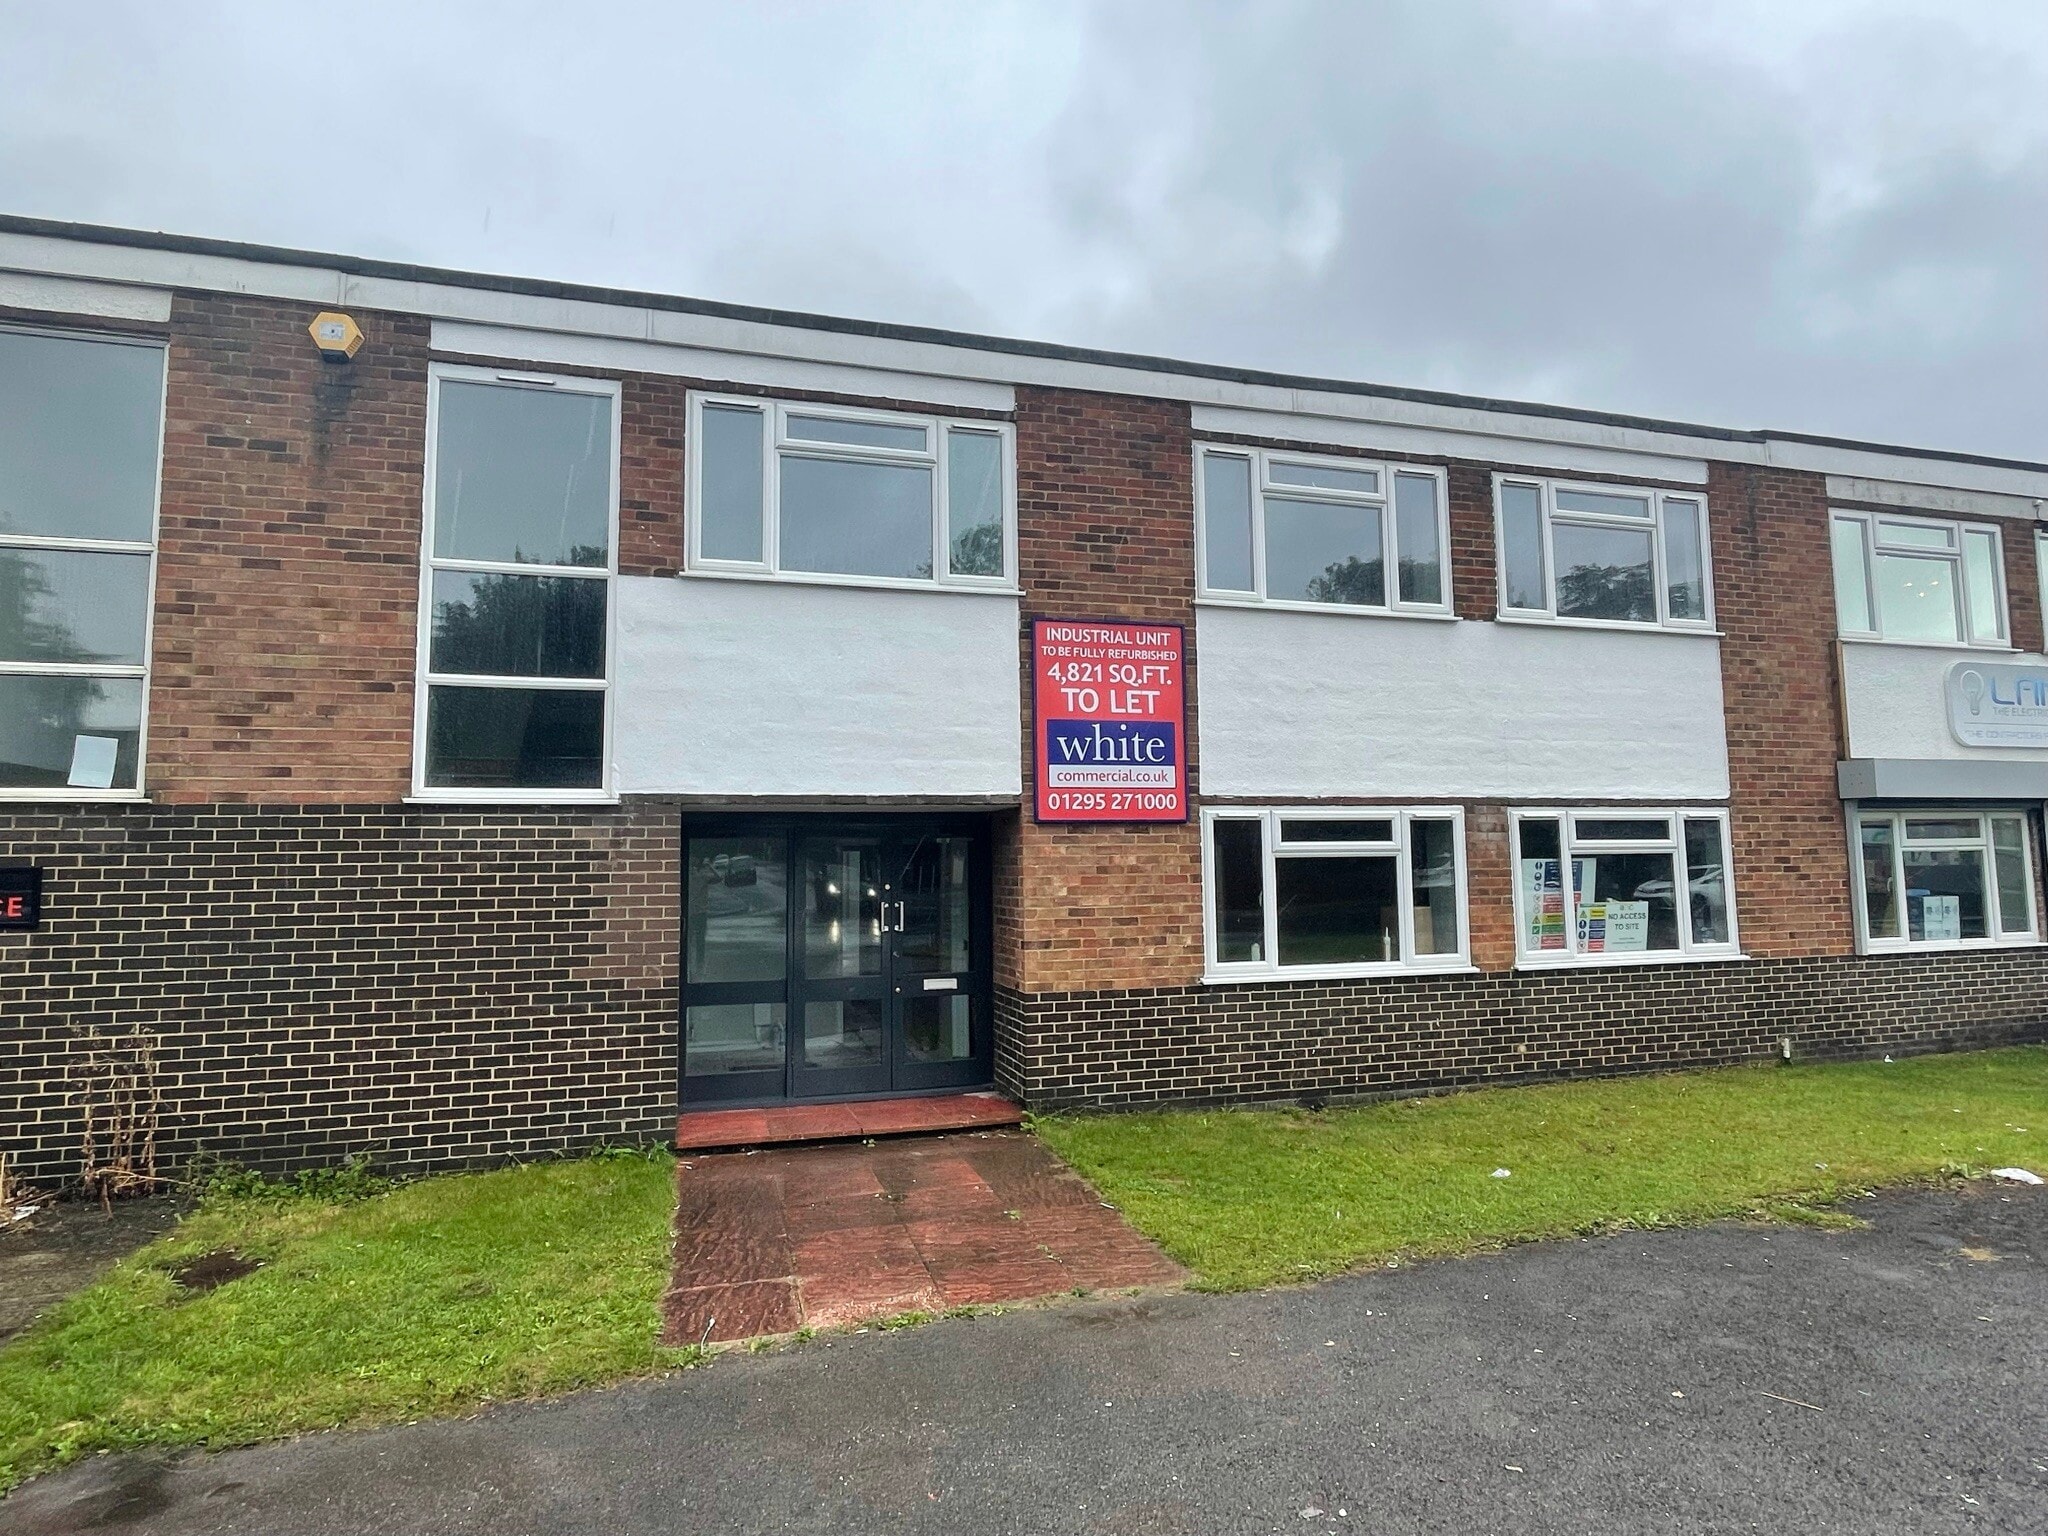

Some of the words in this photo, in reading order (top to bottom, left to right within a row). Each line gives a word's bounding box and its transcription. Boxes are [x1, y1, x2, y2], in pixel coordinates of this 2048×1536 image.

[1047, 628, 1133, 645] INDUSTRIAL
[1136, 632, 1171, 646] UNIT
[1041, 645, 1056, 657] TO
[1058, 647, 1071, 657] BE
[1073, 648, 1106, 659] FULLY
[1108, 649, 1177, 661] REFURBISHED
[1047, 662, 1103, 685] 4,821
[1109, 664, 1172, 687] SQ.FT.
[1061, 688, 1099, 713] TO
[1110, 689, 1160, 714] LET
[1989, 677, 2048, 706] LA
[1056, 723, 1166, 762] white
[1057, 770, 1169, 783] commercial.co.uk
[1049, 794, 1106, 810] 01295
[1111, 794, 1177, 810] 271000
[0, 897, 22, 917] E
